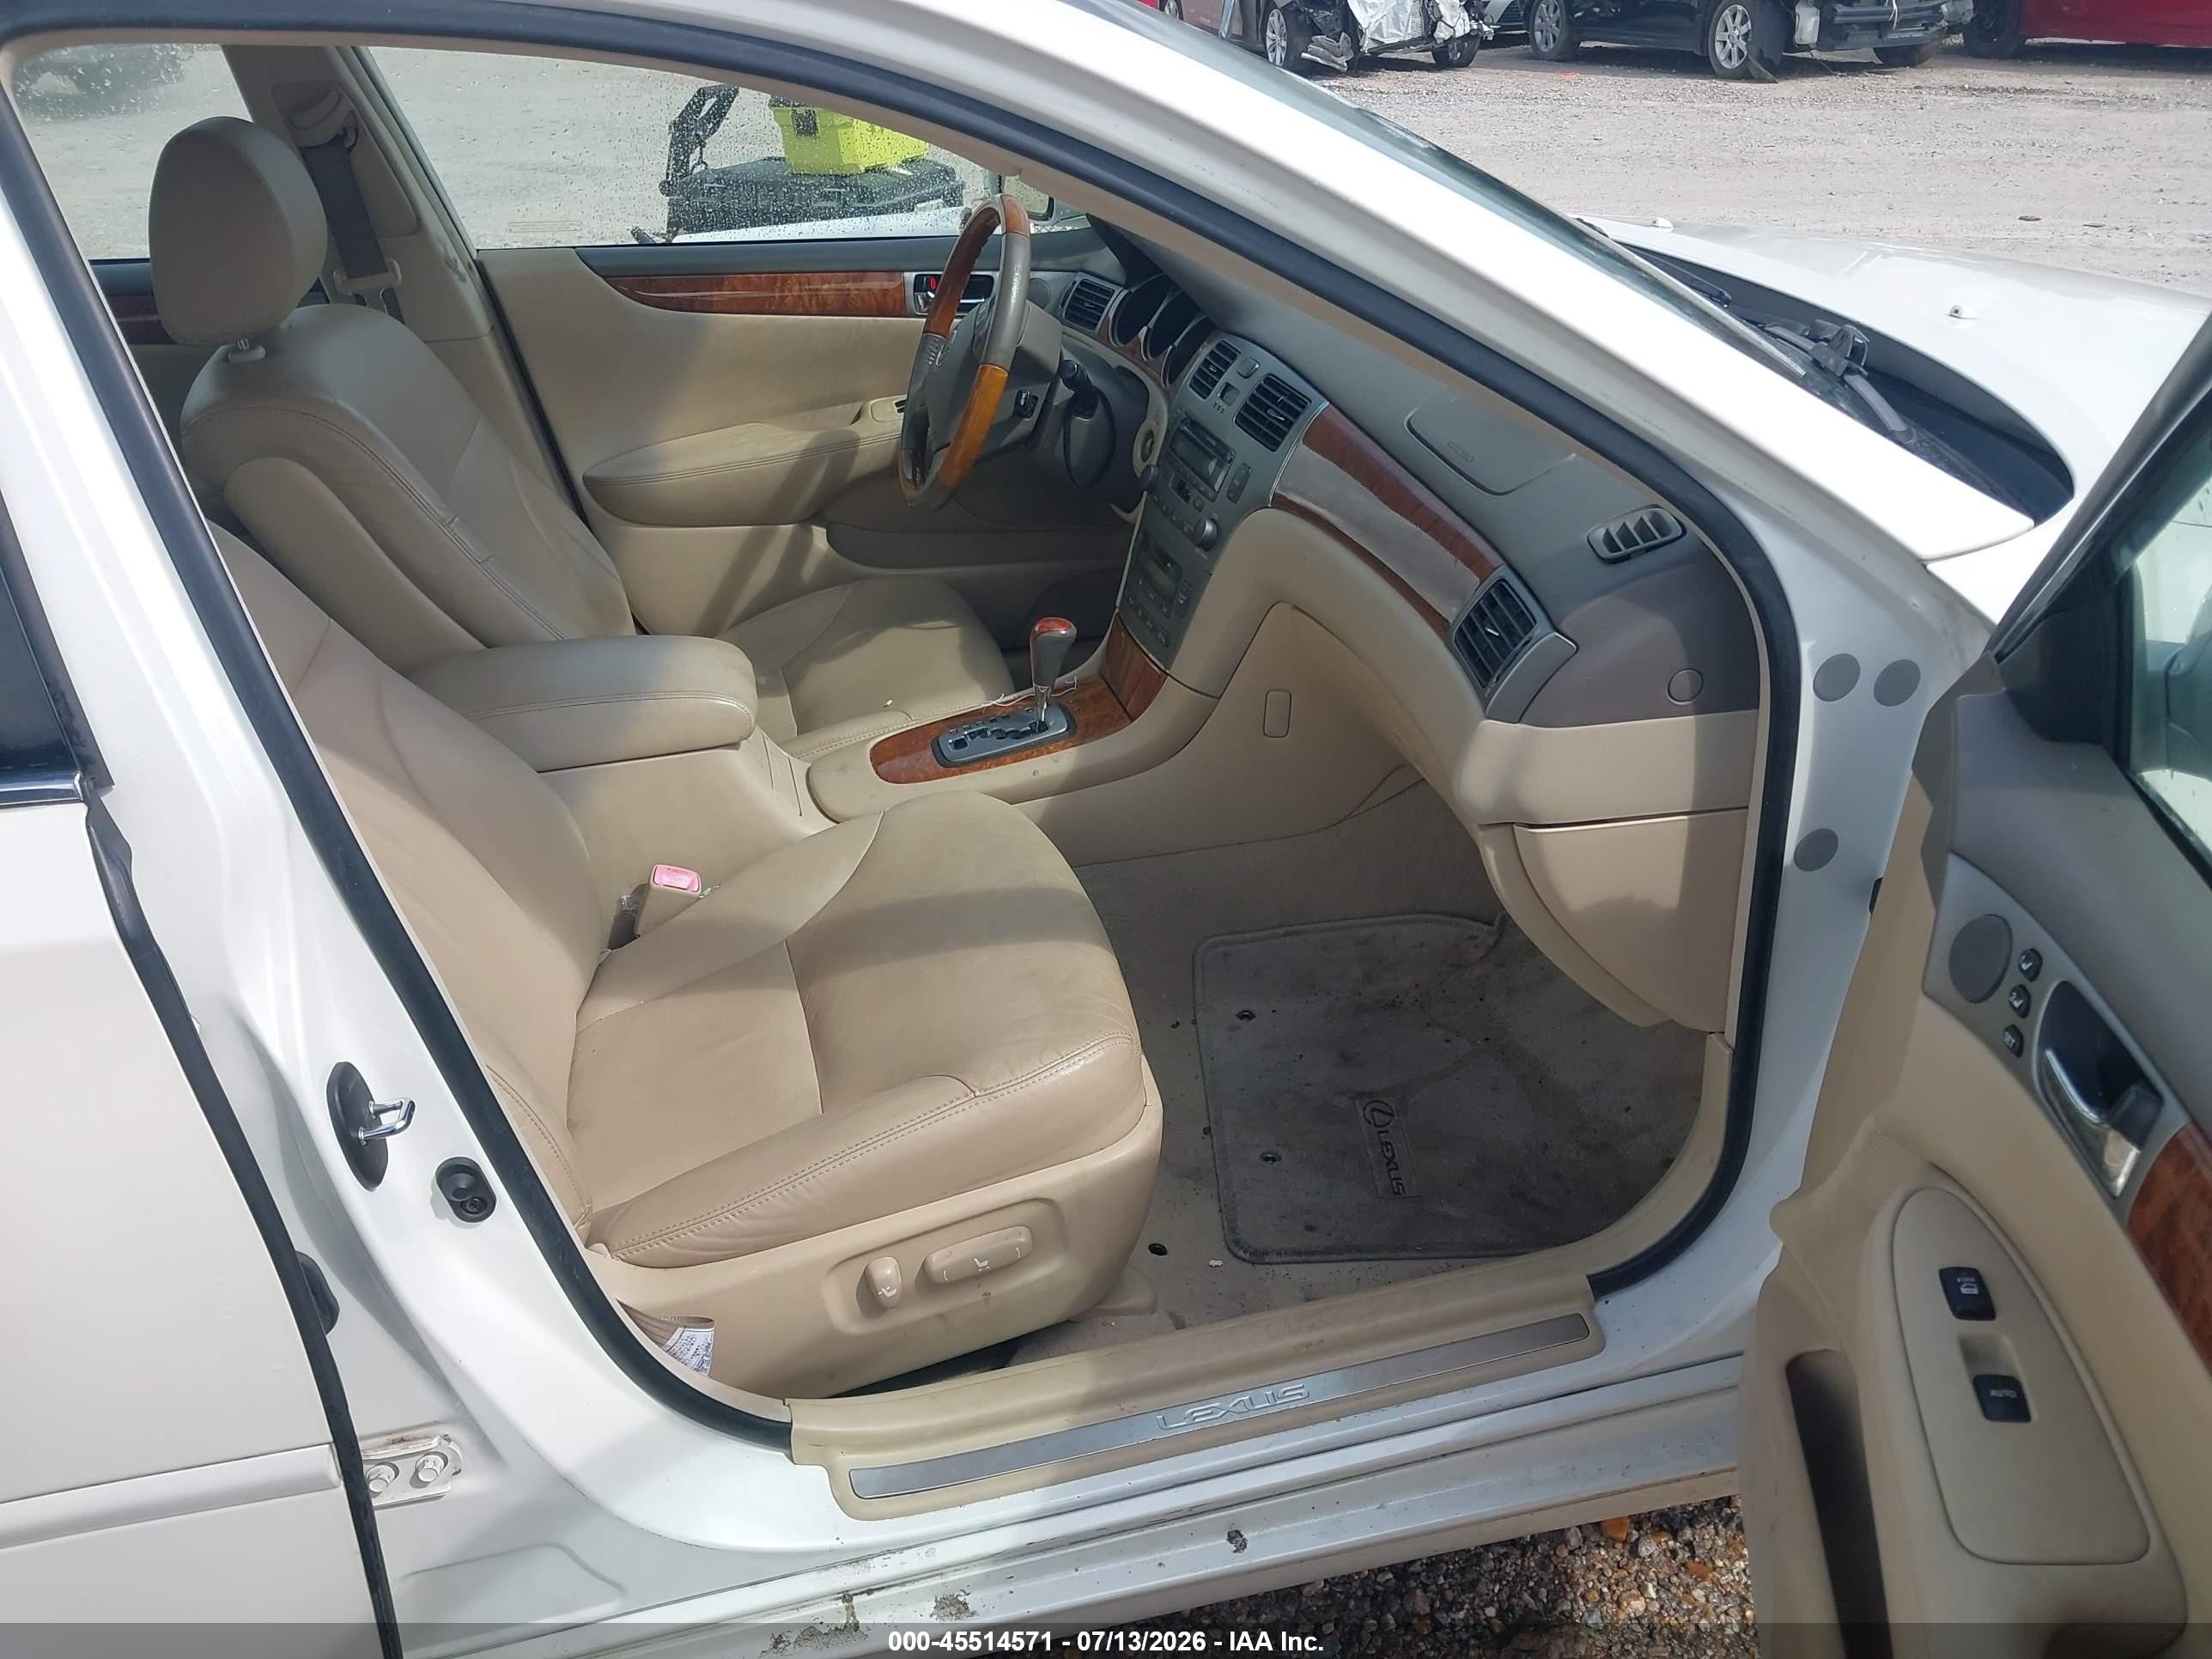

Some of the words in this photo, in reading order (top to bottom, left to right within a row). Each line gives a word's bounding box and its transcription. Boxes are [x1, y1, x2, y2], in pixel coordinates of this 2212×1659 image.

[1377, 1130, 1406, 1195] LEXUS
[1157, 1383, 1310, 1430] LEXUS
[1990, 1389, 2017, 1398] AUTO
